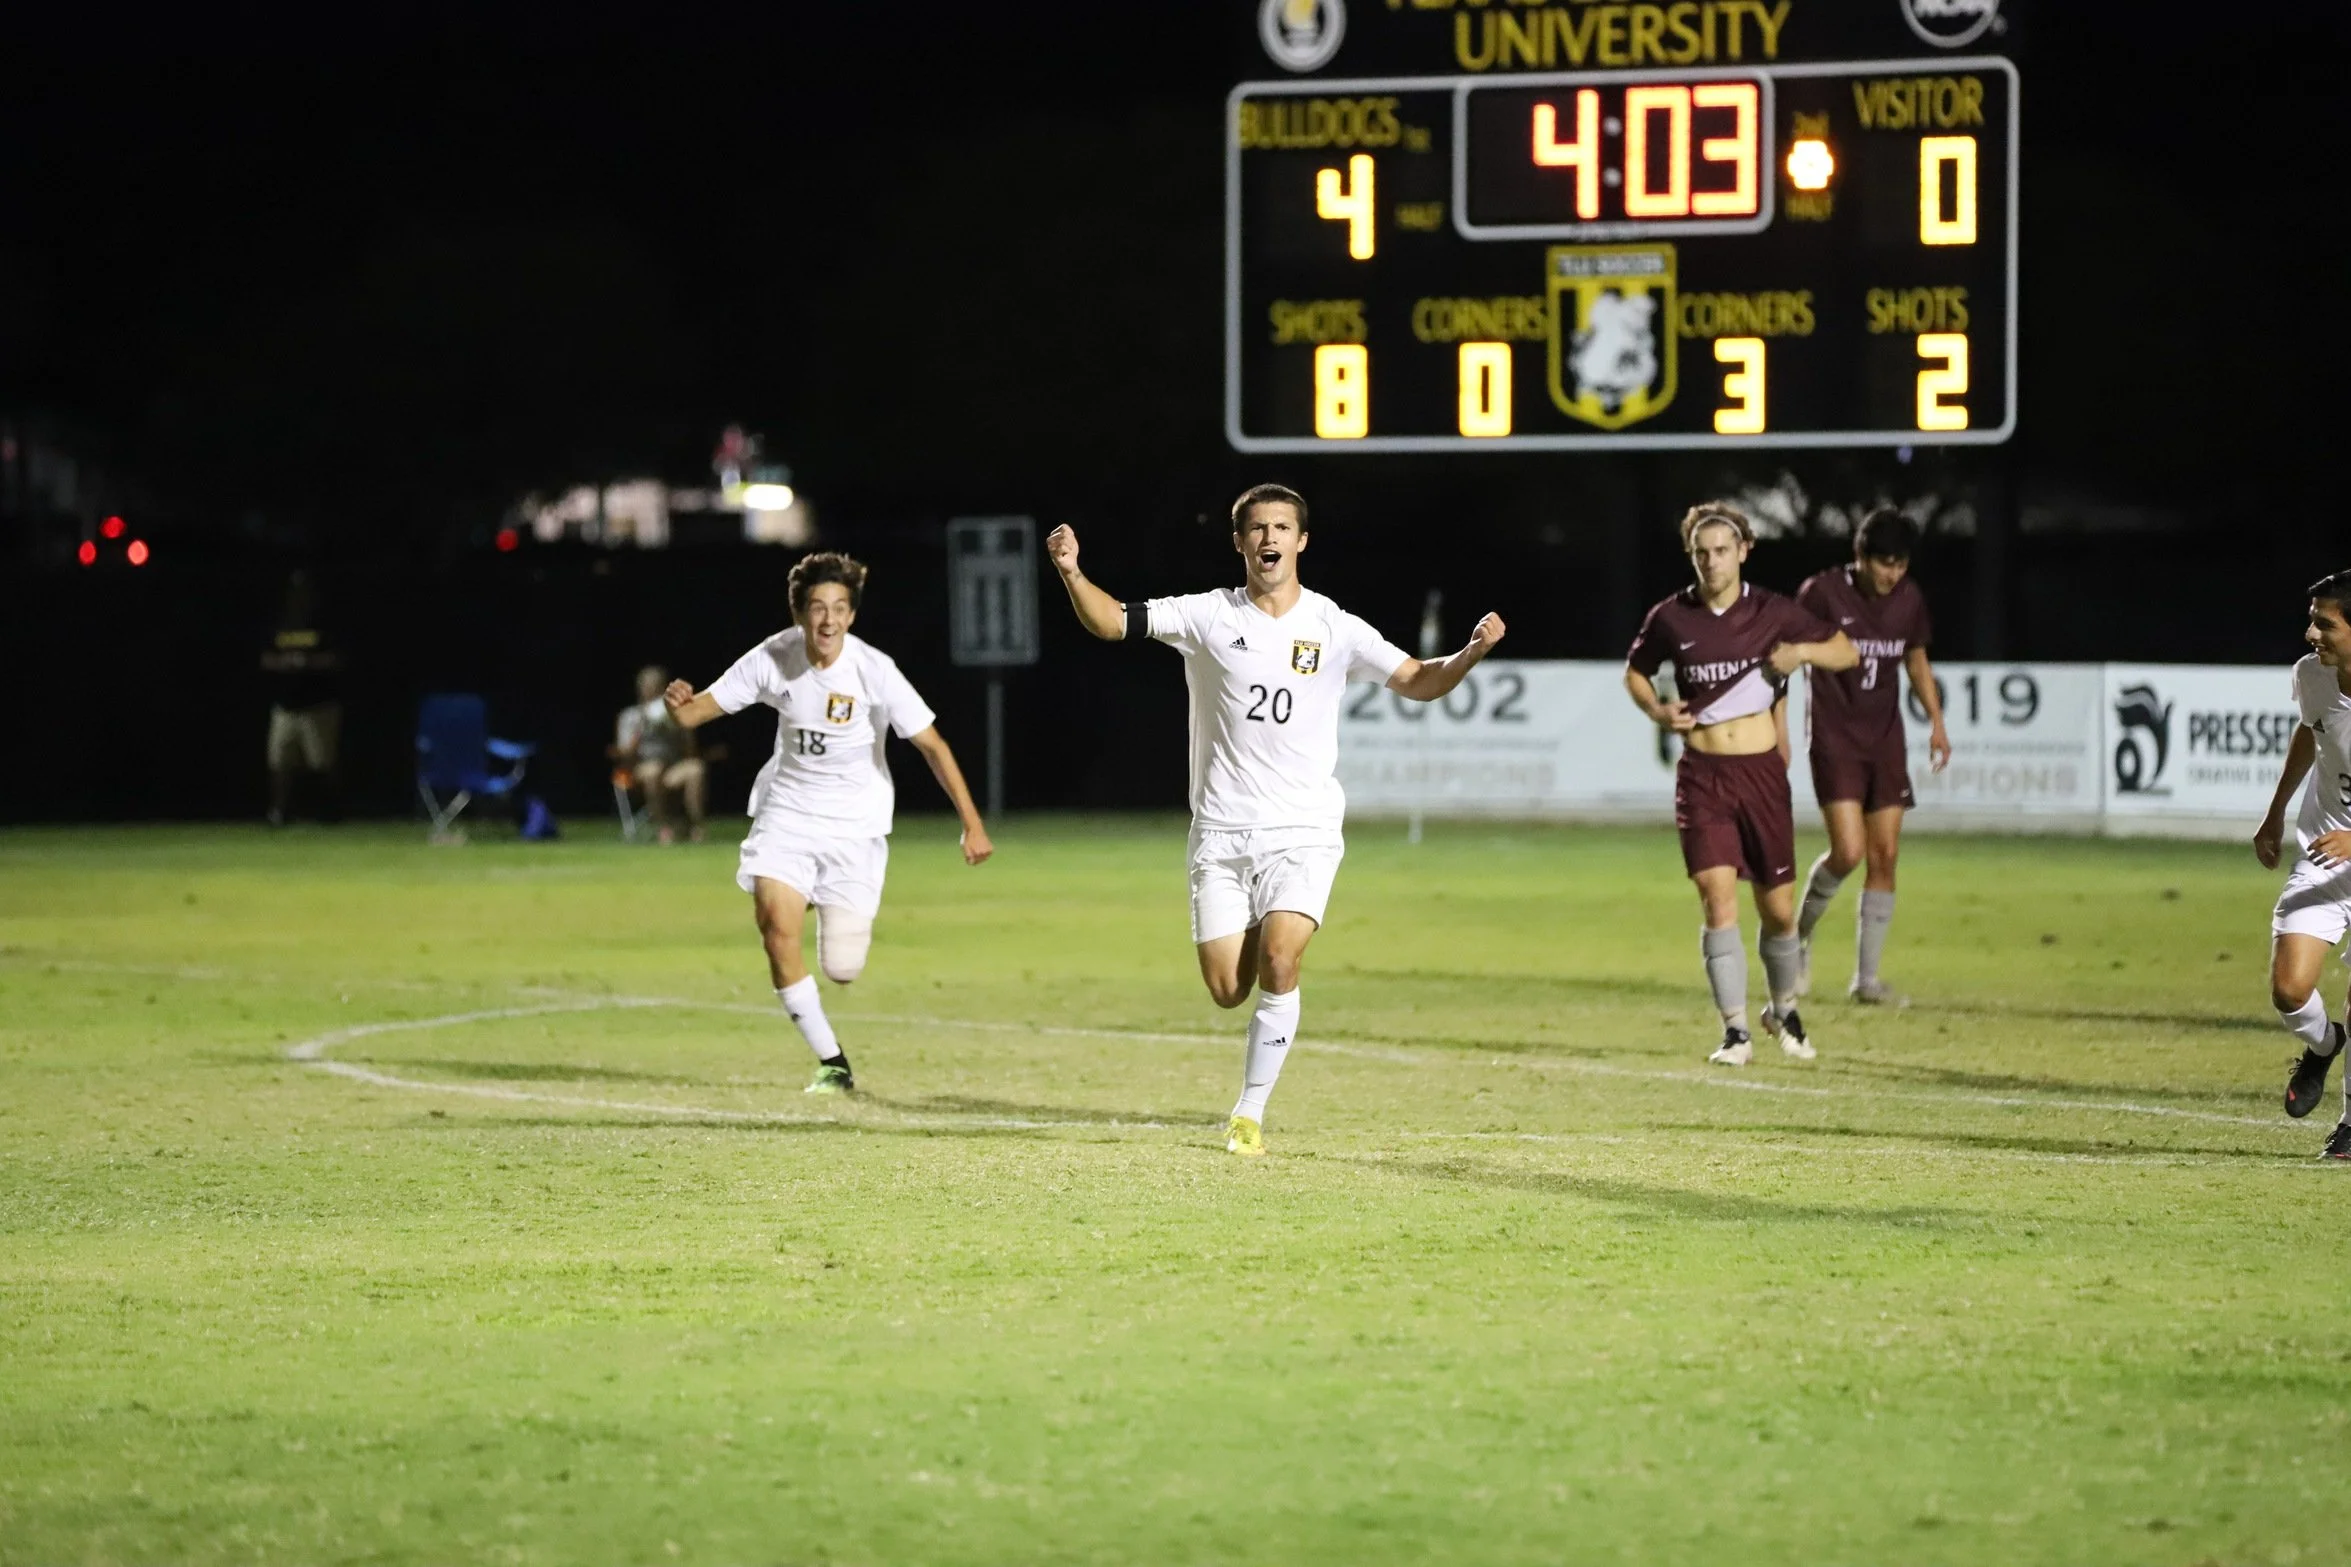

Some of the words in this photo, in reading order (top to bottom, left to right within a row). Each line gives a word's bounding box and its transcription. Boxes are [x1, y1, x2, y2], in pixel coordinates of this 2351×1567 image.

[1454, 2, 1791, 72] UNIVERSITY
[1239, 98, 1400, 148] BULLDOGS
[1853, 76, 1984, 129] VISITOR
[1532, 83, 1758, 219] 4:03
[1316, 154, 1375, 259] 4
[1920, 136, 1977, 245] 0
[1269, 299, 1367, 344] SHOTS
[1412, 296, 1547, 341] CORNERS
[1678, 290, 1815, 337] CORNERS
[1866, 287, 1970, 333] SHOTS
[1315, 344, 1368, 438] 8
[1459, 342, 1512, 436] 0
[1714, 338, 1766, 433] 3
[1917, 333, 1968, 430] 2
[1861, 657, 1878, 690] 3
[1907, 673, 2039, 725] 019
[1246, 685, 1292, 724] 20
[798, 729, 826, 756] 18
